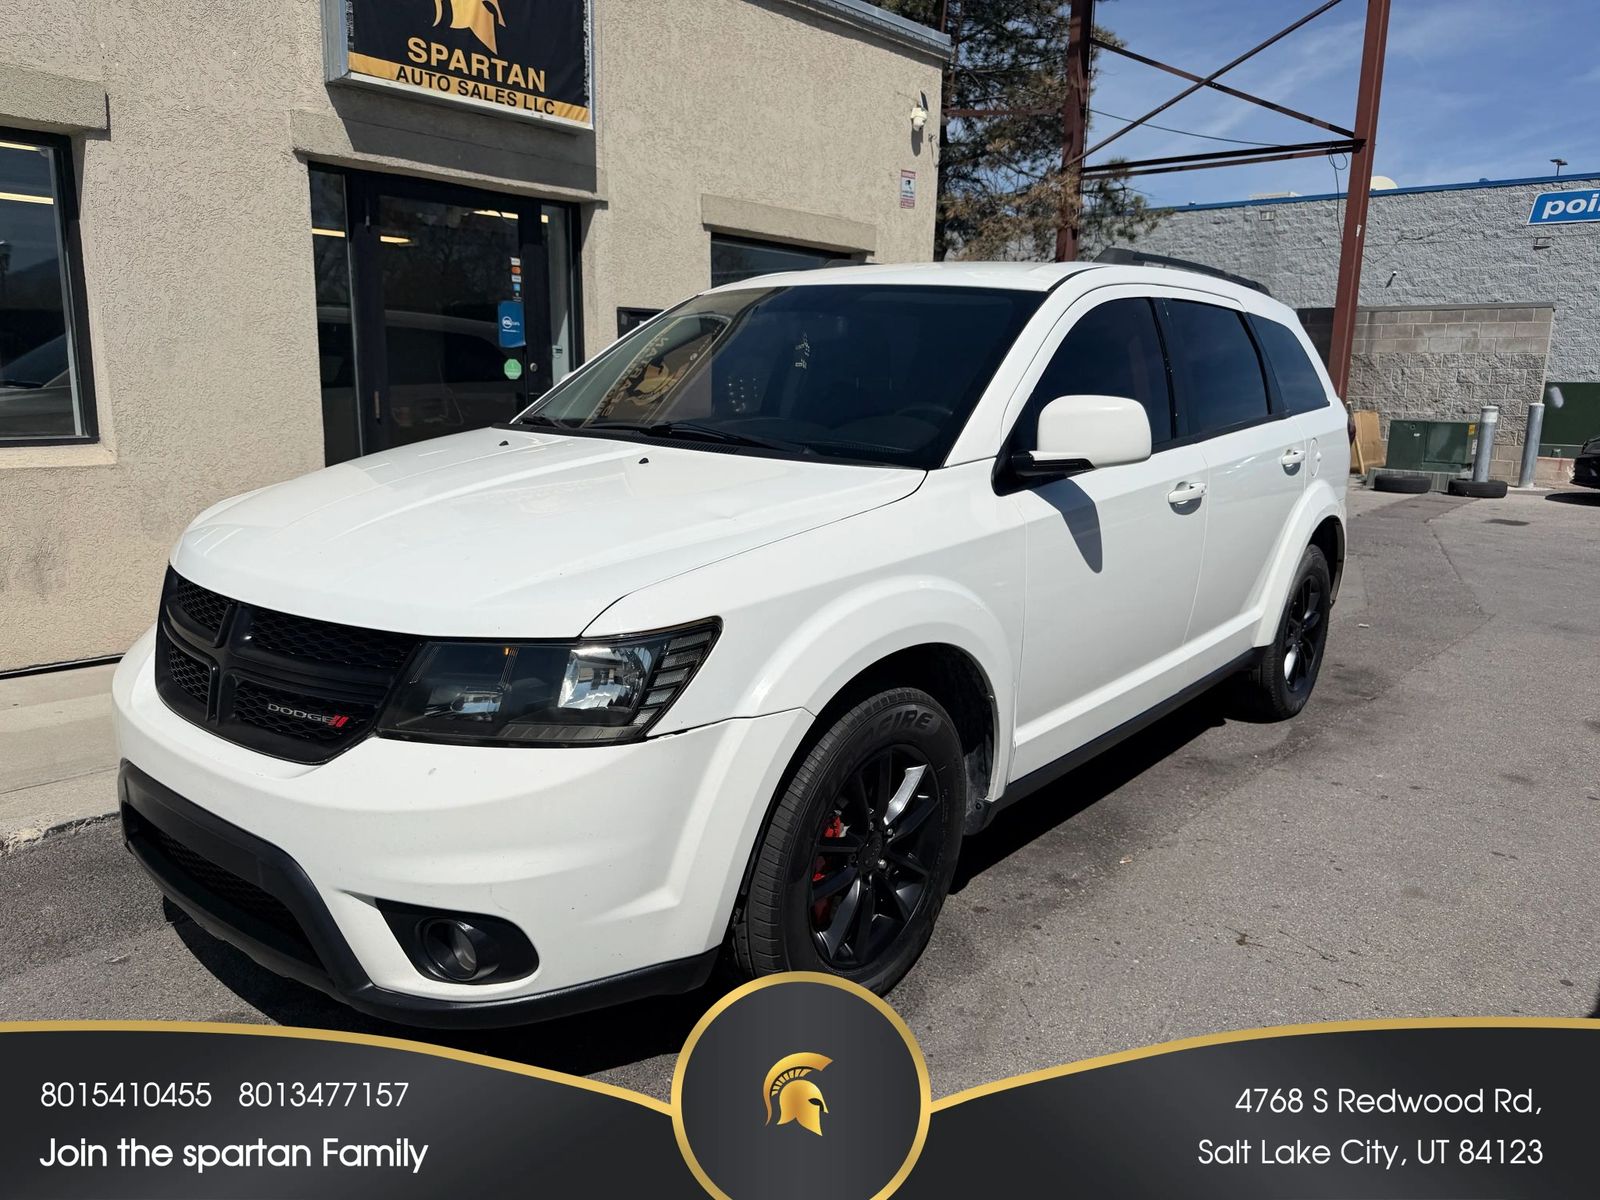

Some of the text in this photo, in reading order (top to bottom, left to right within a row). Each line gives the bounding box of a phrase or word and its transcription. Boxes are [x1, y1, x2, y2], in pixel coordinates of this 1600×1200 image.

[407, 36, 546, 93] SPARTAN
[396, 66, 555, 115] AUTO SALES LLC
[1541, 193, 1600, 220] poi
[267, 703, 335, 726] DODGE
